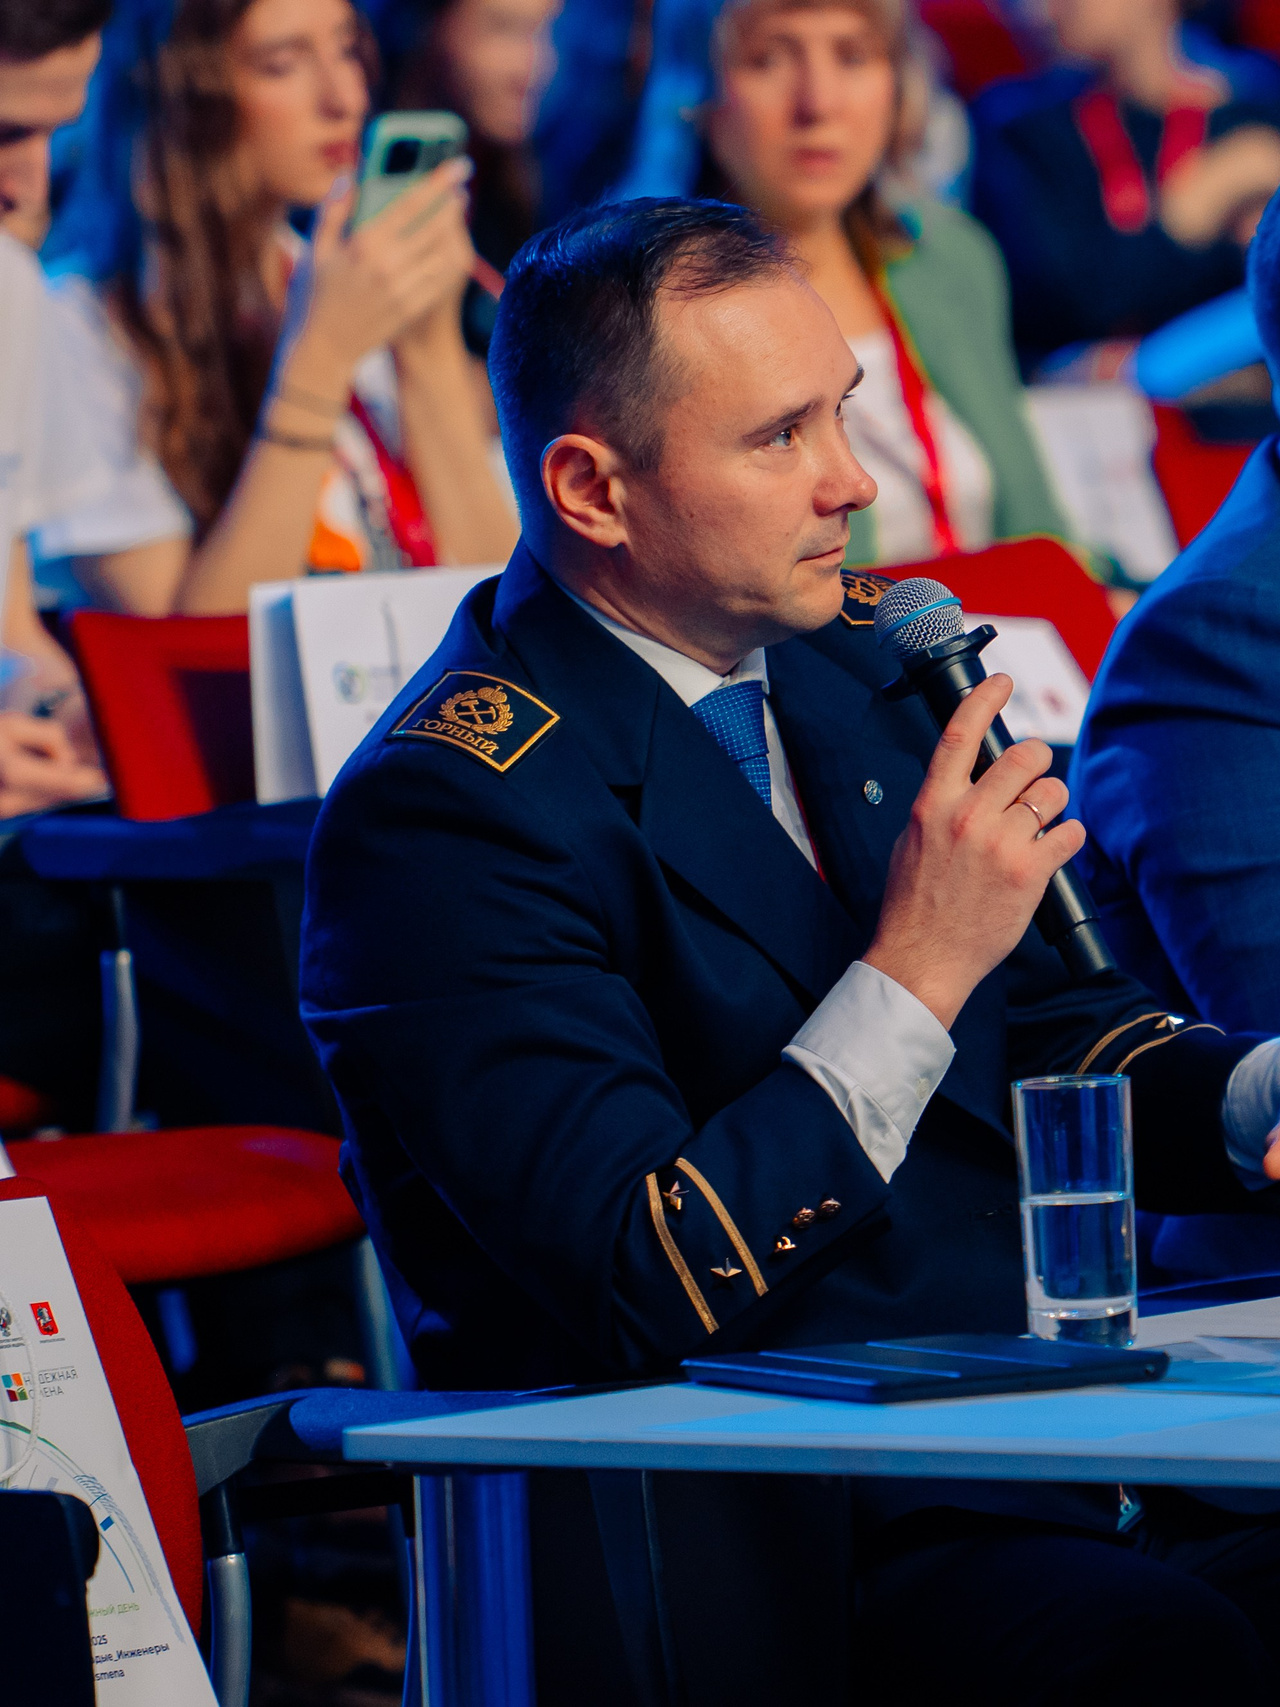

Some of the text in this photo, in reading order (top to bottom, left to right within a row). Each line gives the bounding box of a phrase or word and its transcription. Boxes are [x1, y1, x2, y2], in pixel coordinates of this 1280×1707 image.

[412, 719, 499, 755] ГОРНЫЙ
[23, 1369, 78, 1386] НДЕЖНАЯ
[91, 1634, 108, 1646] 025
[95, 1669, 125, 1681] smena
